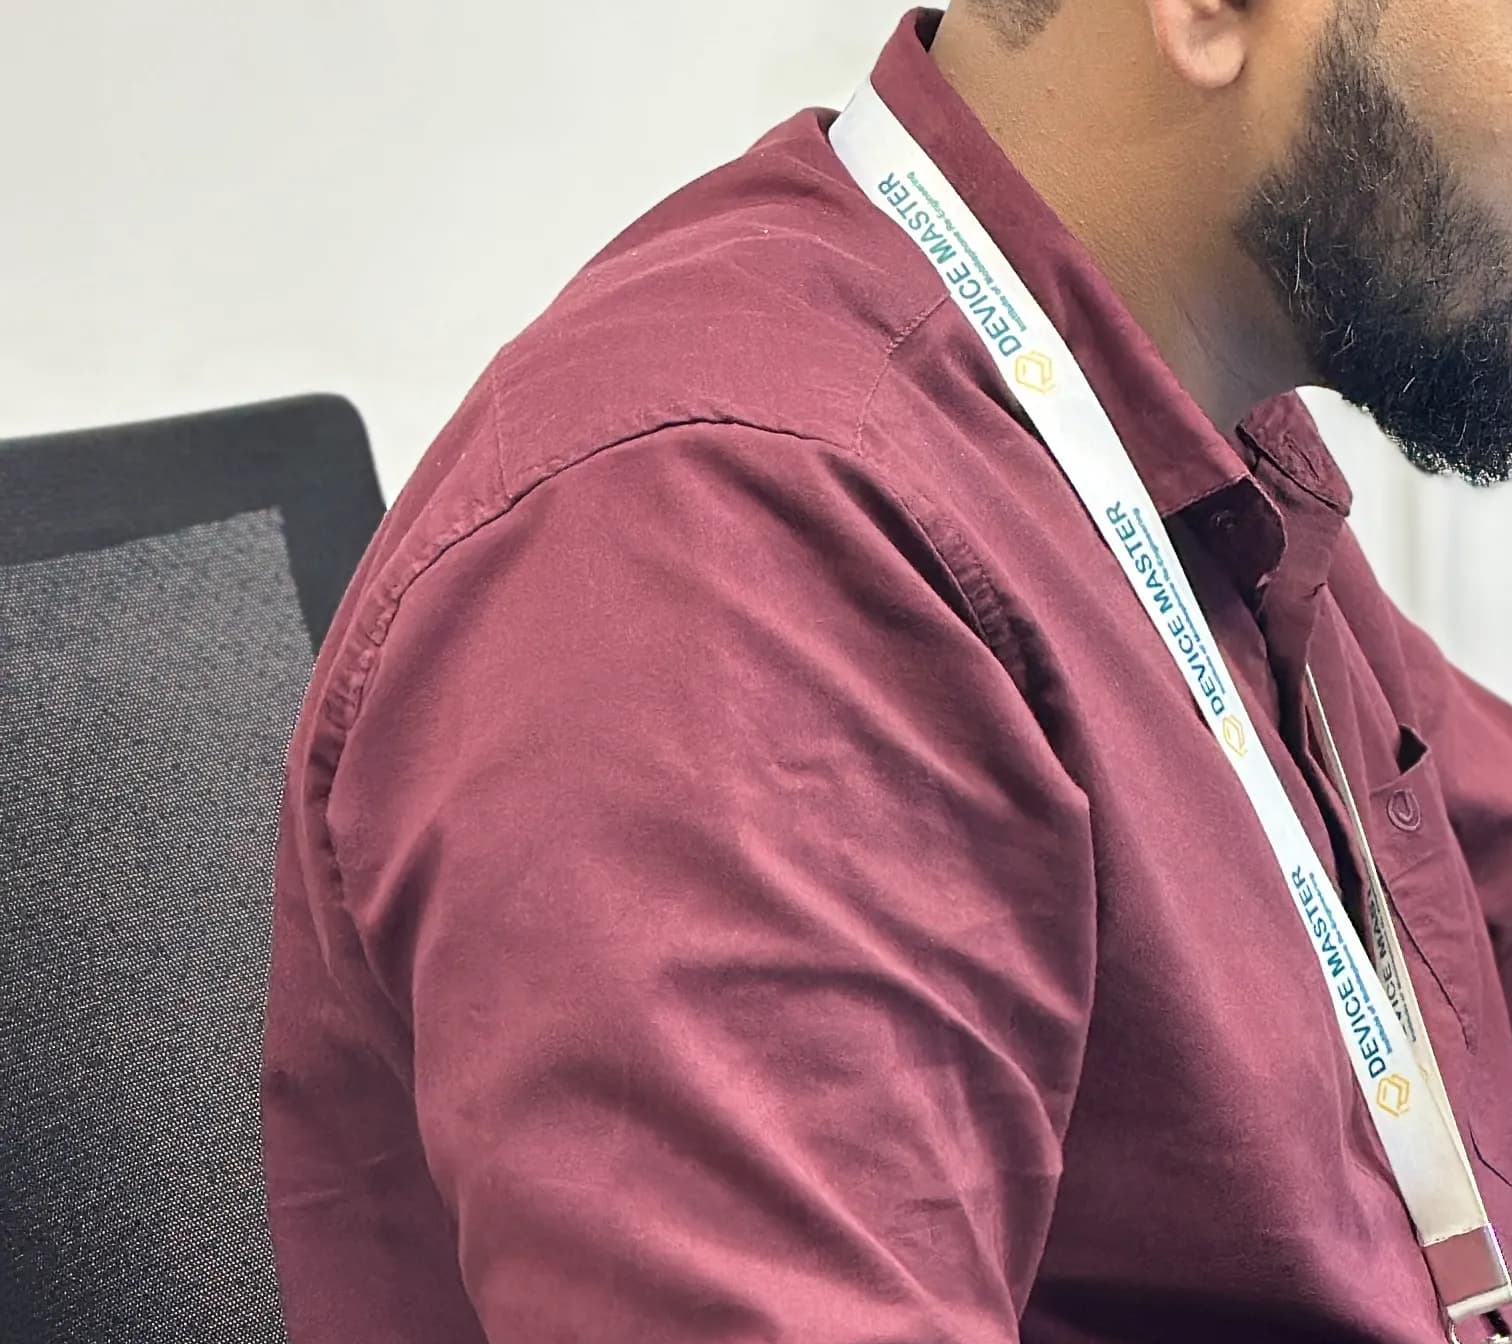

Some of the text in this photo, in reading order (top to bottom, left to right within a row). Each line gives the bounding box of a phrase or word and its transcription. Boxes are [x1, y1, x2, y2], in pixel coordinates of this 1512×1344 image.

[877, 172, 1021, 357] DEVICE MASTER
[1106, 501, 1174, 614] MASTER
[1167, 615, 1225, 715] DEVICE
[1291, 865, 1387, 1078] DEVICE MASTER
